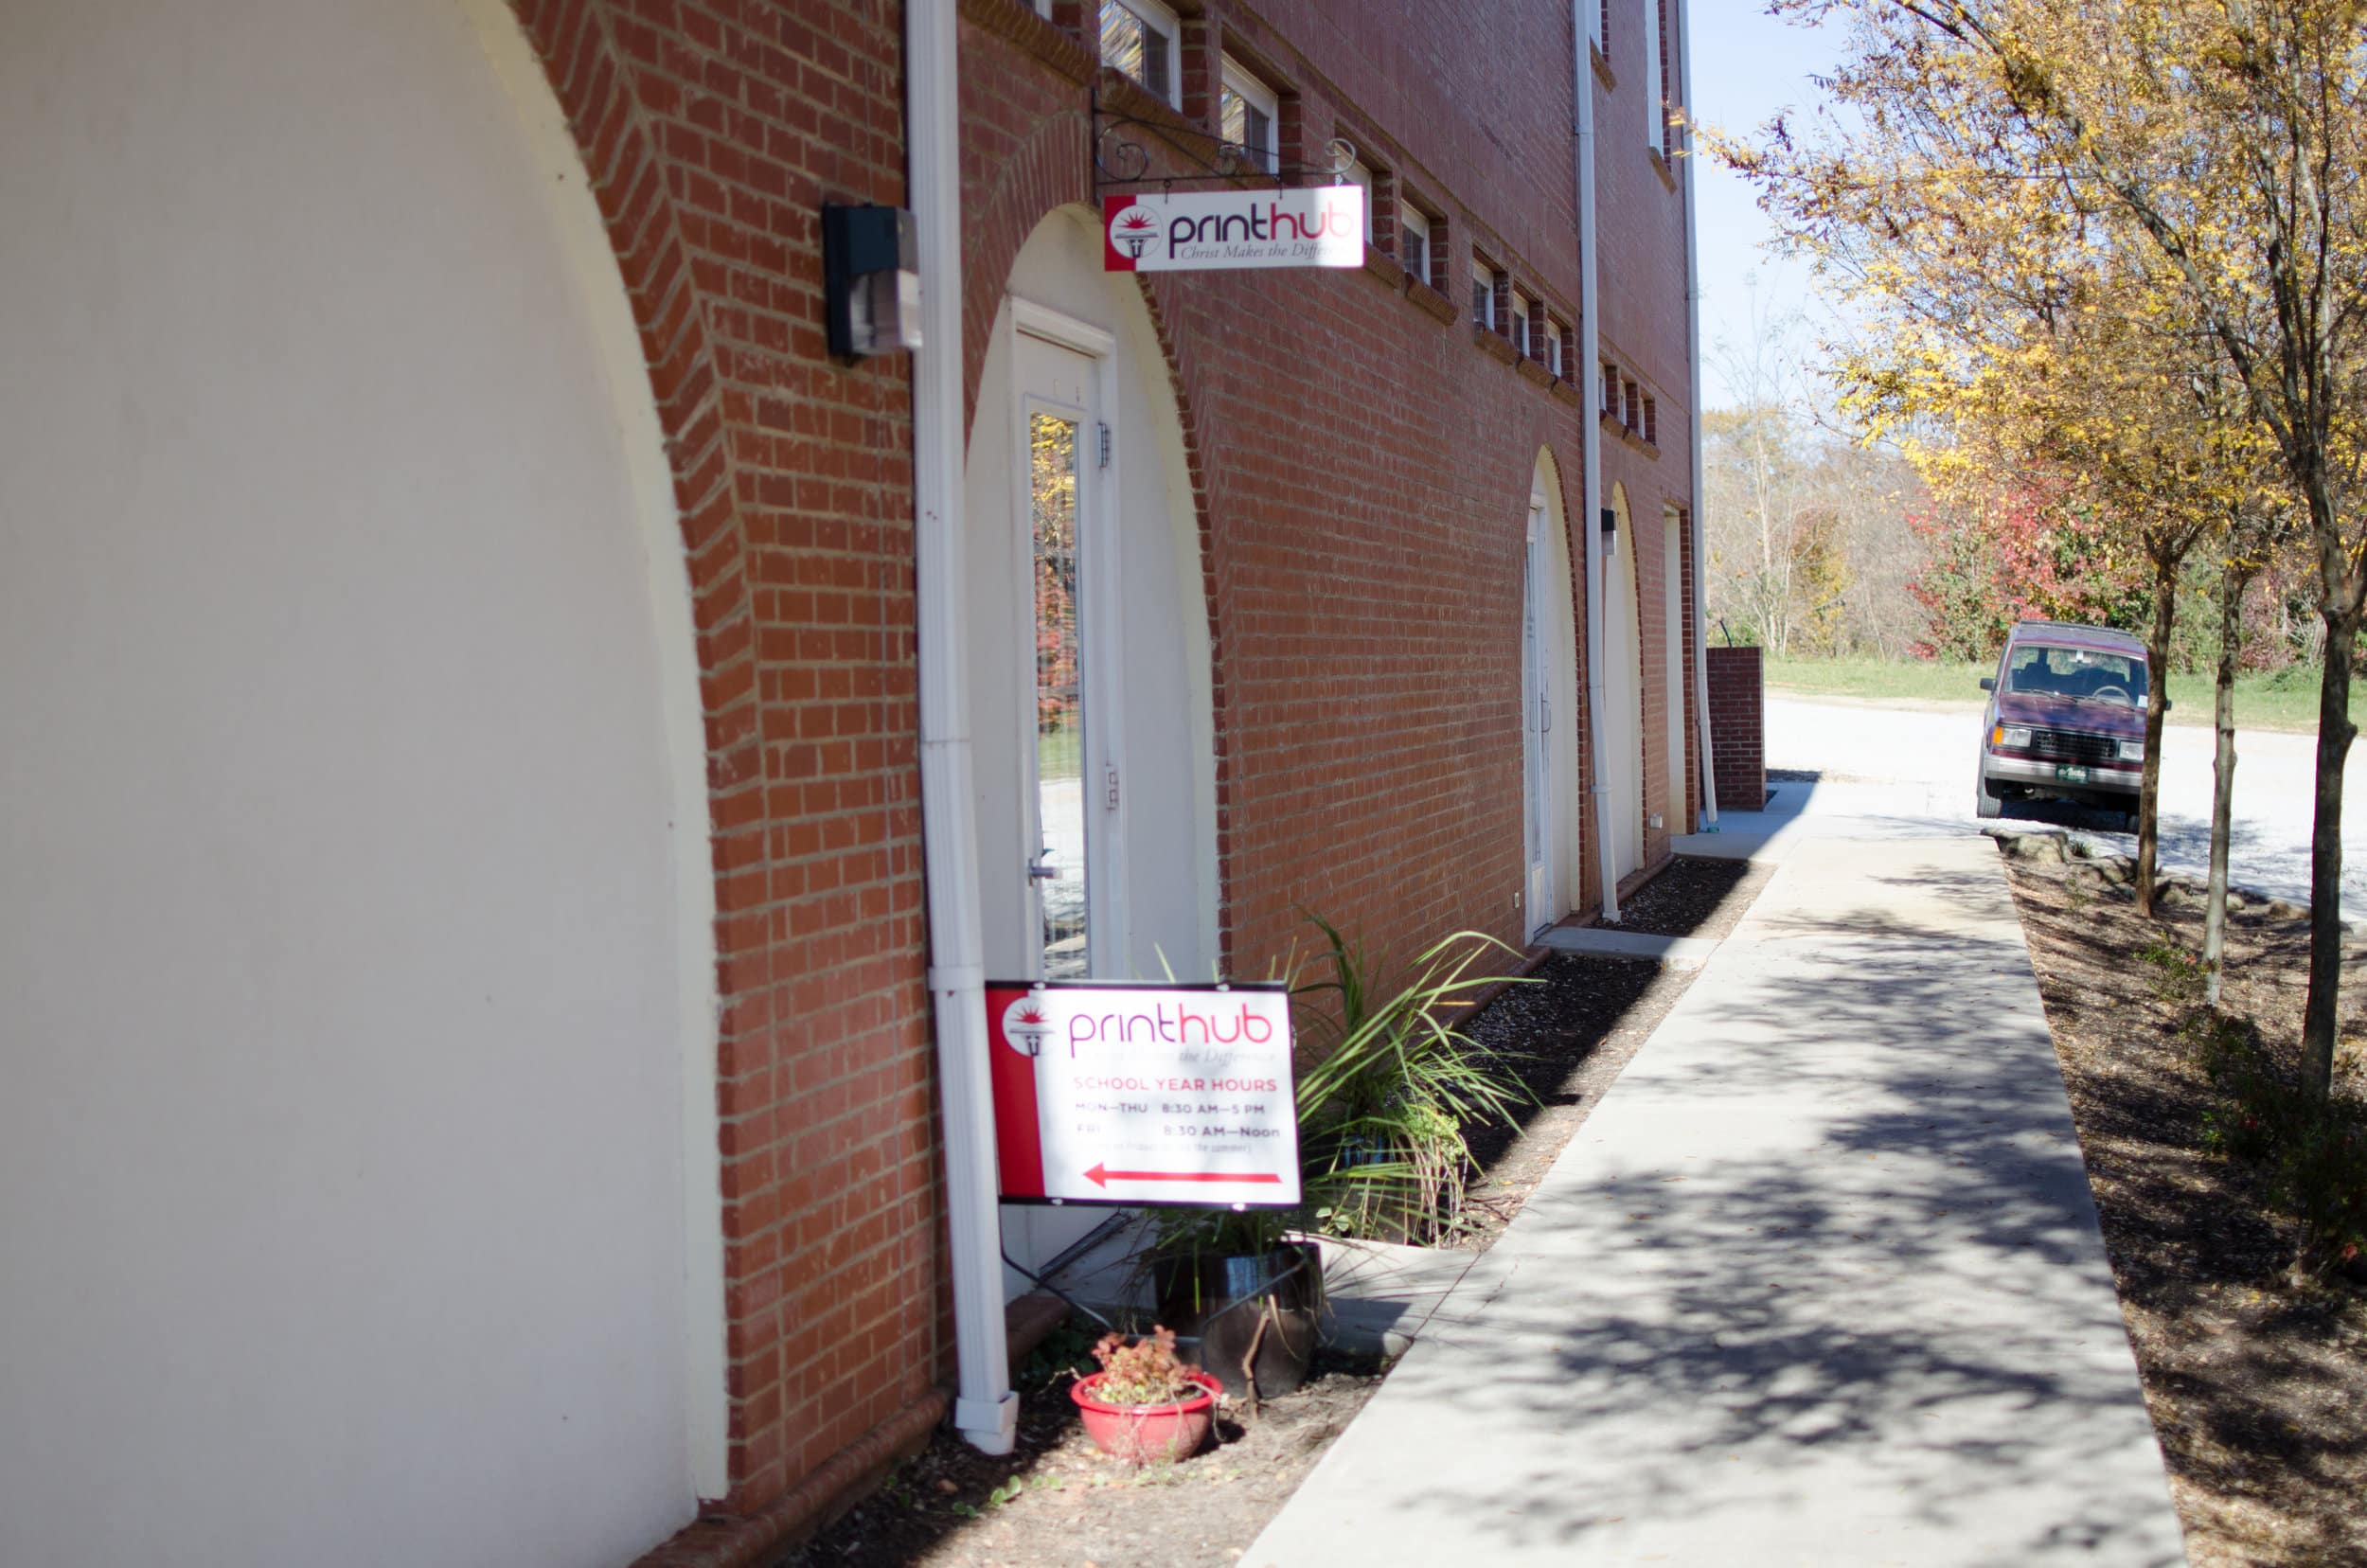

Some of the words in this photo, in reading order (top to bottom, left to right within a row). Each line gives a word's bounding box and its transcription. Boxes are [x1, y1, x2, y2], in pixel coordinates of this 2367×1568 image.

[1168, 200, 1354, 259] printhub
[1181, 246, 1219, 260] Christ
[1222, 244, 1264, 259] Makes
[1268, 244, 1288, 258] the
[1069, 1002, 1272, 1059] printhub
[1074, 1077, 1149, 1090] SCHOOL
[1155, 1078, 1205, 1091] YEAR
[1211, 1078, 1277, 1092] HOURS
[1162, 1103, 1192, 1114] 8:30
[1244, 1104, 1266, 1114] PM
